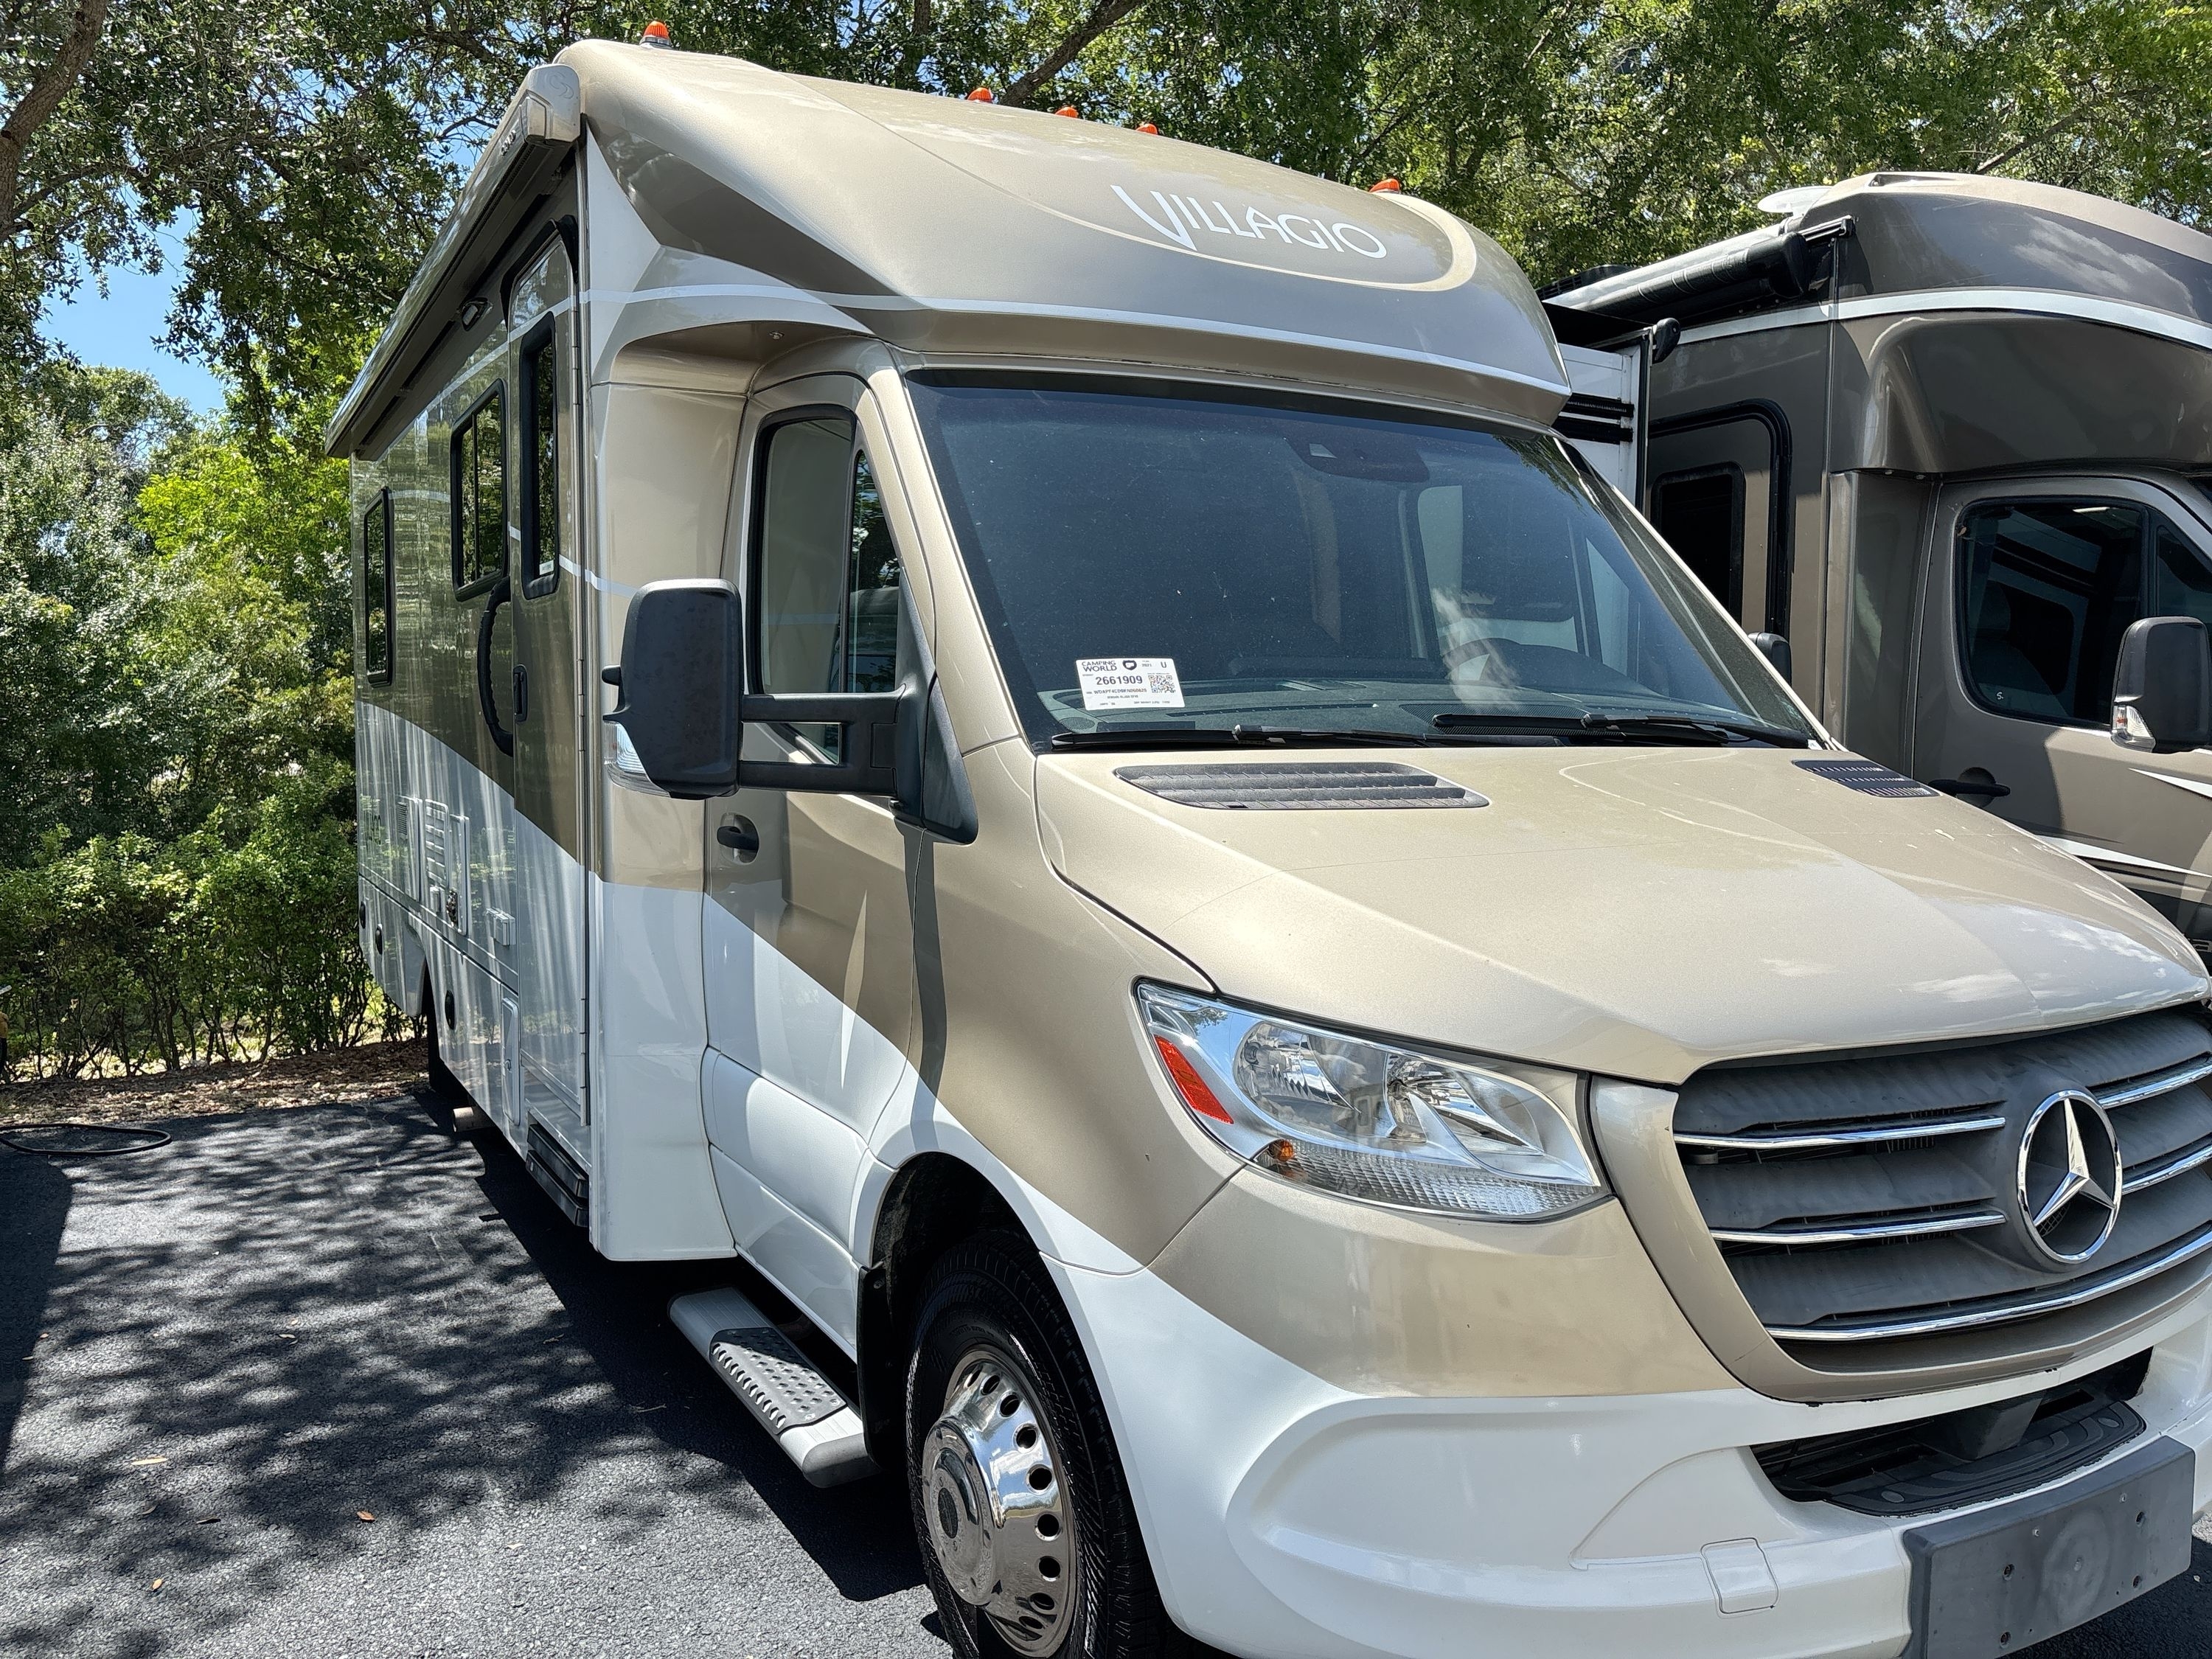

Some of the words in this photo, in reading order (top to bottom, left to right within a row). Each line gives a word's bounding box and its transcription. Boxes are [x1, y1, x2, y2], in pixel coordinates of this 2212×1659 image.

[1110, 184, 1388, 260] VILLAGIO
[1160, 661, 1167, 669] U
[1095, 675, 1143, 686] 2661909
